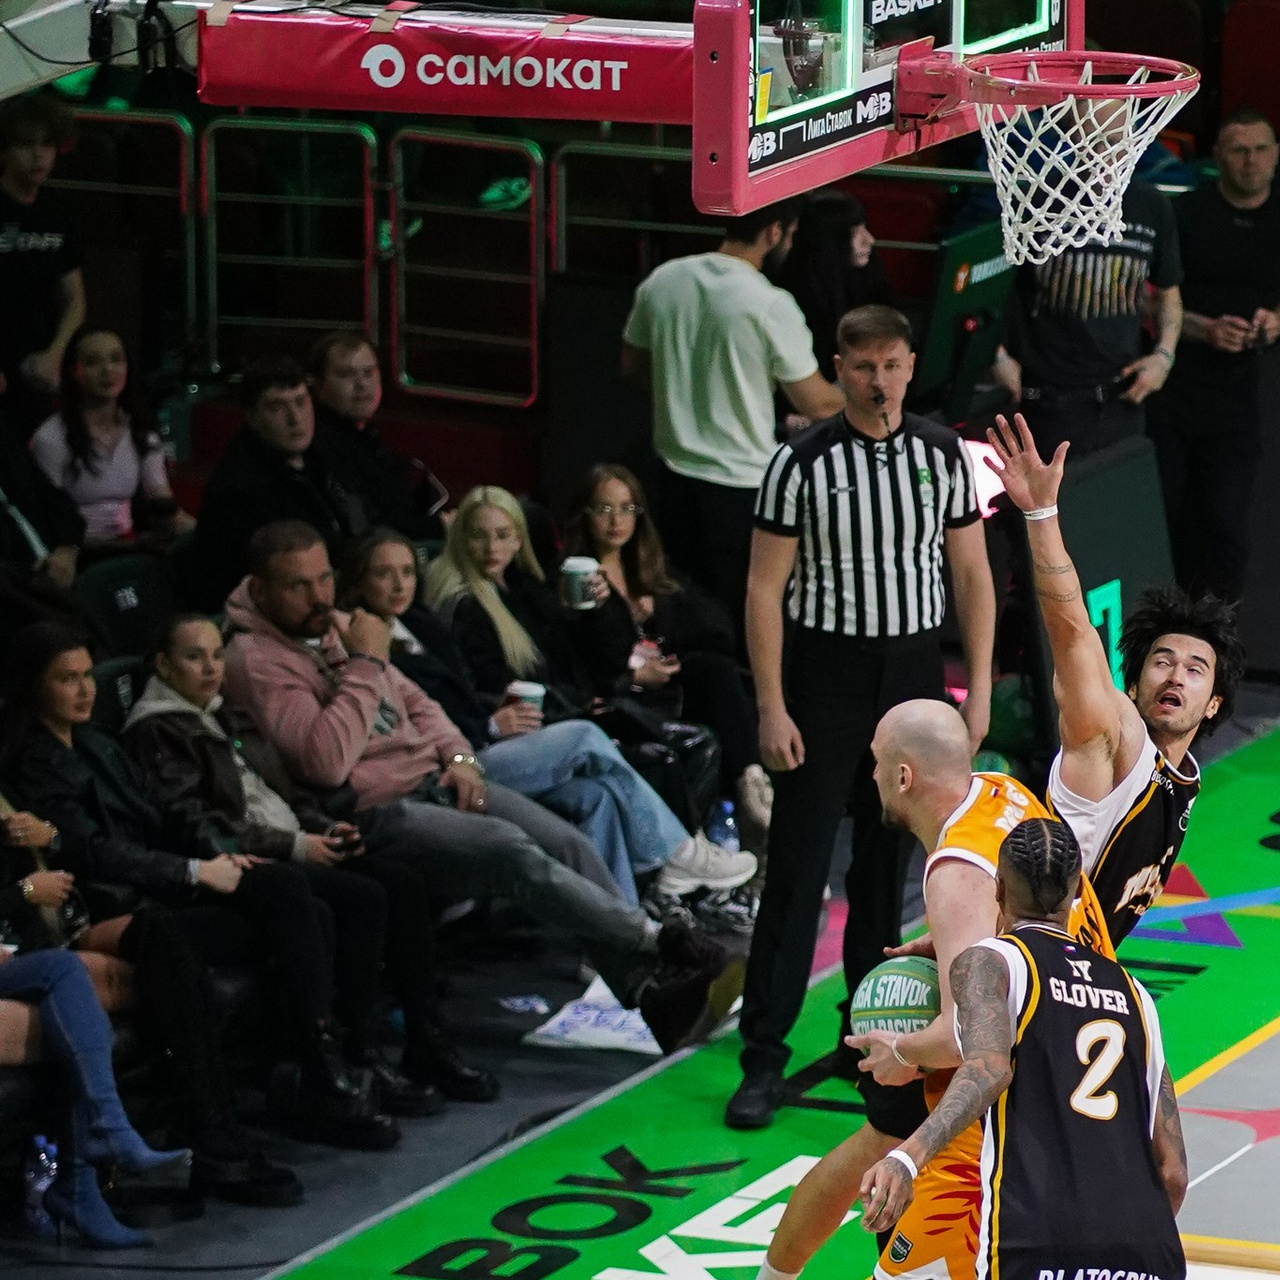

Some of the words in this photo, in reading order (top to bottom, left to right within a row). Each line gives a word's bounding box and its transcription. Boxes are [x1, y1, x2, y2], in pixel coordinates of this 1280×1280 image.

[416, 54, 628, 91] самокат
[874, 975, 931, 1008] STAVOK
[1049, 976, 1130, 1015] GLOVER
[1069, 1018, 1127, 1121] 2
